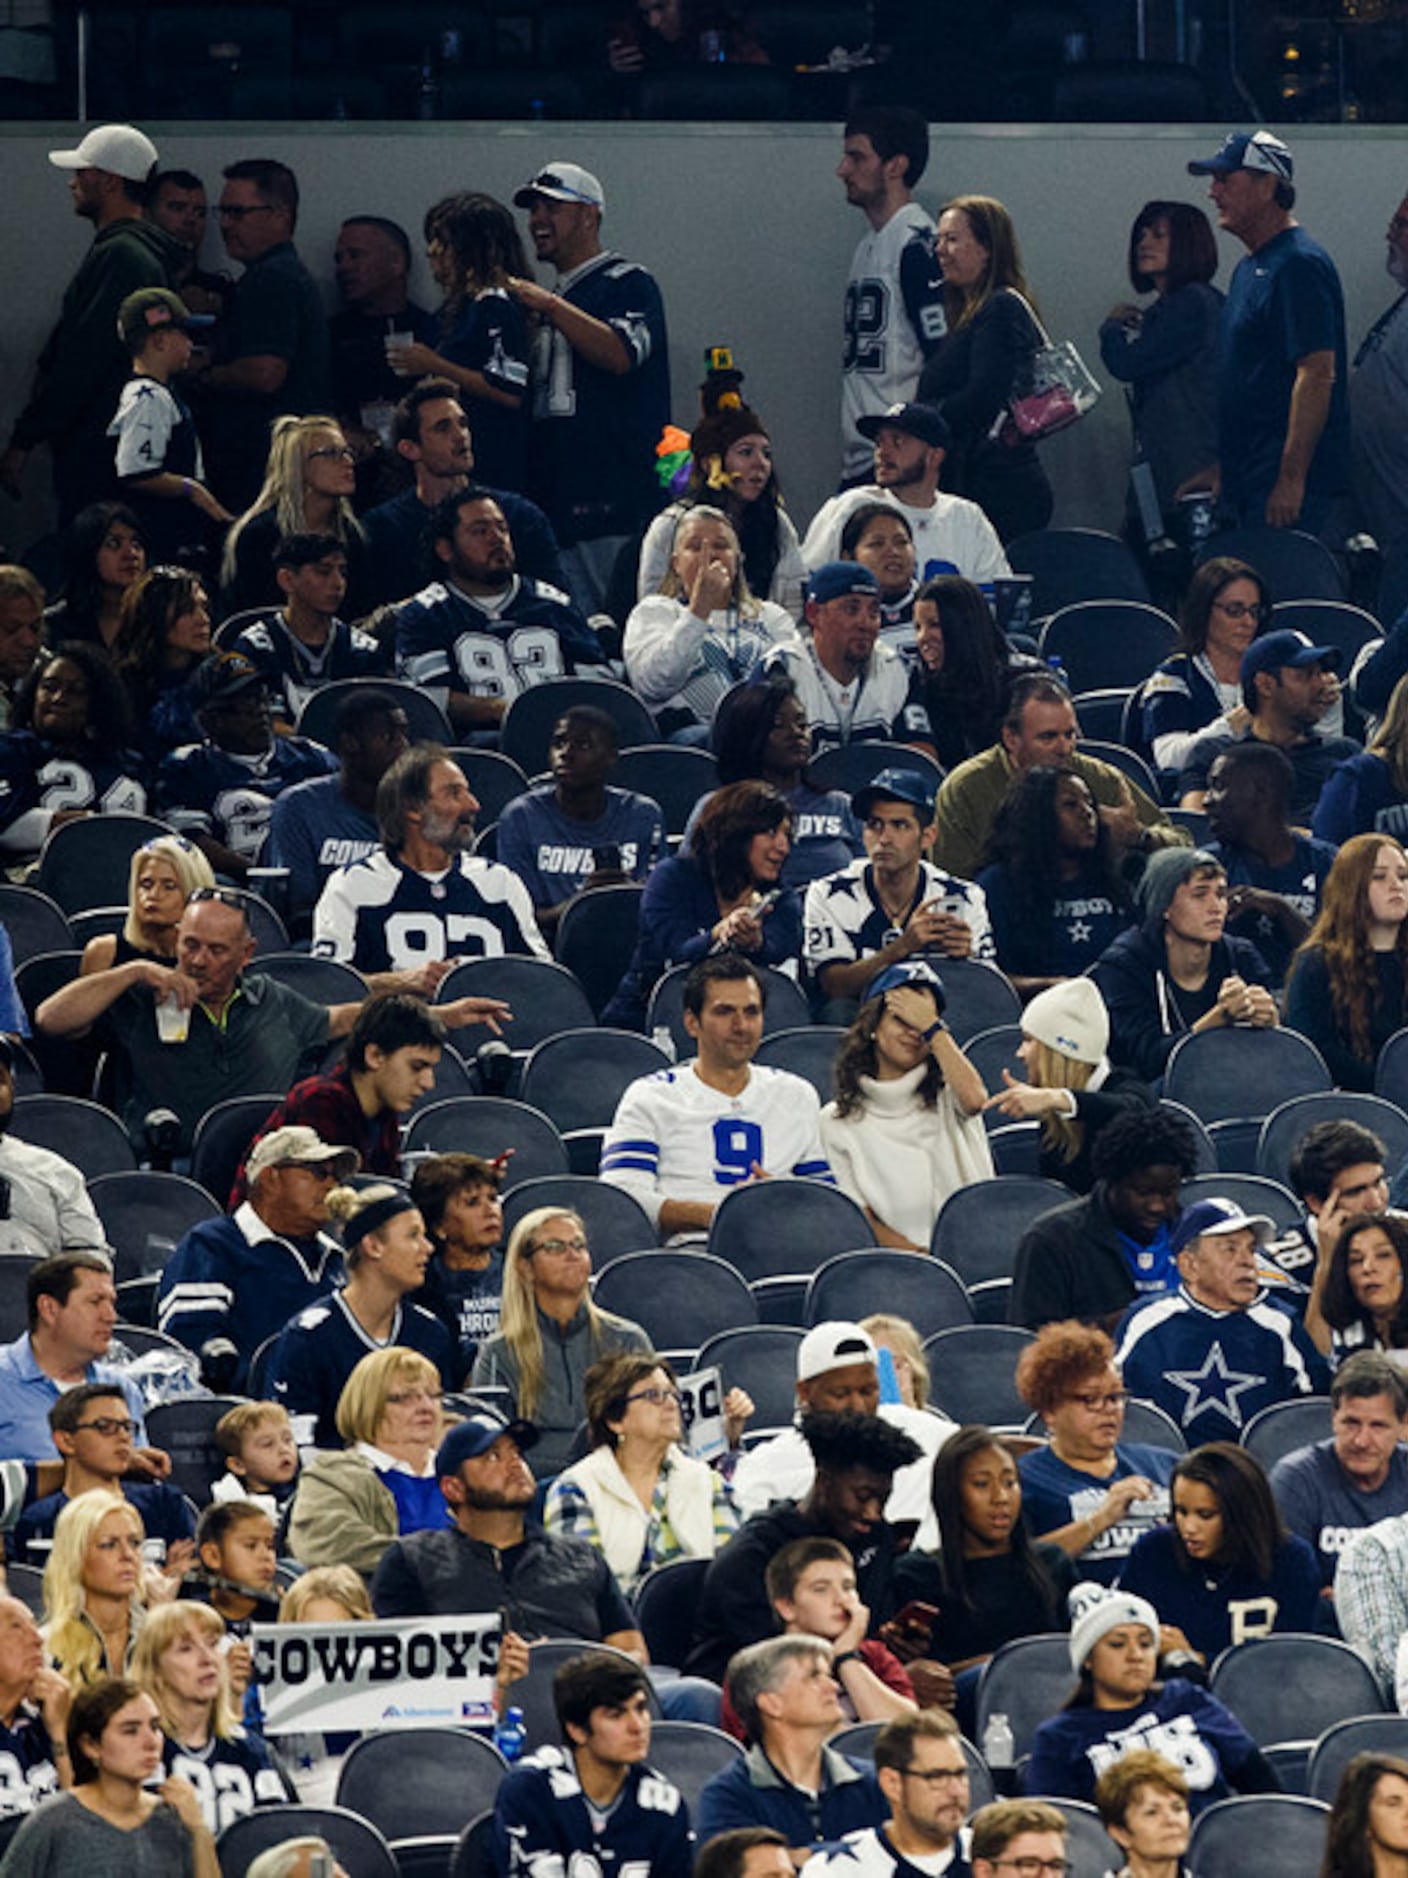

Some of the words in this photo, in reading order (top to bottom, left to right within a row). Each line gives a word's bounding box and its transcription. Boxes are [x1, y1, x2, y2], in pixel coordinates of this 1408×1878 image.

[808, 925, 834, 954] 21
[713, 1118, 763, 1187] 9
[253, 1629, 501, 1687] COWBOYS
